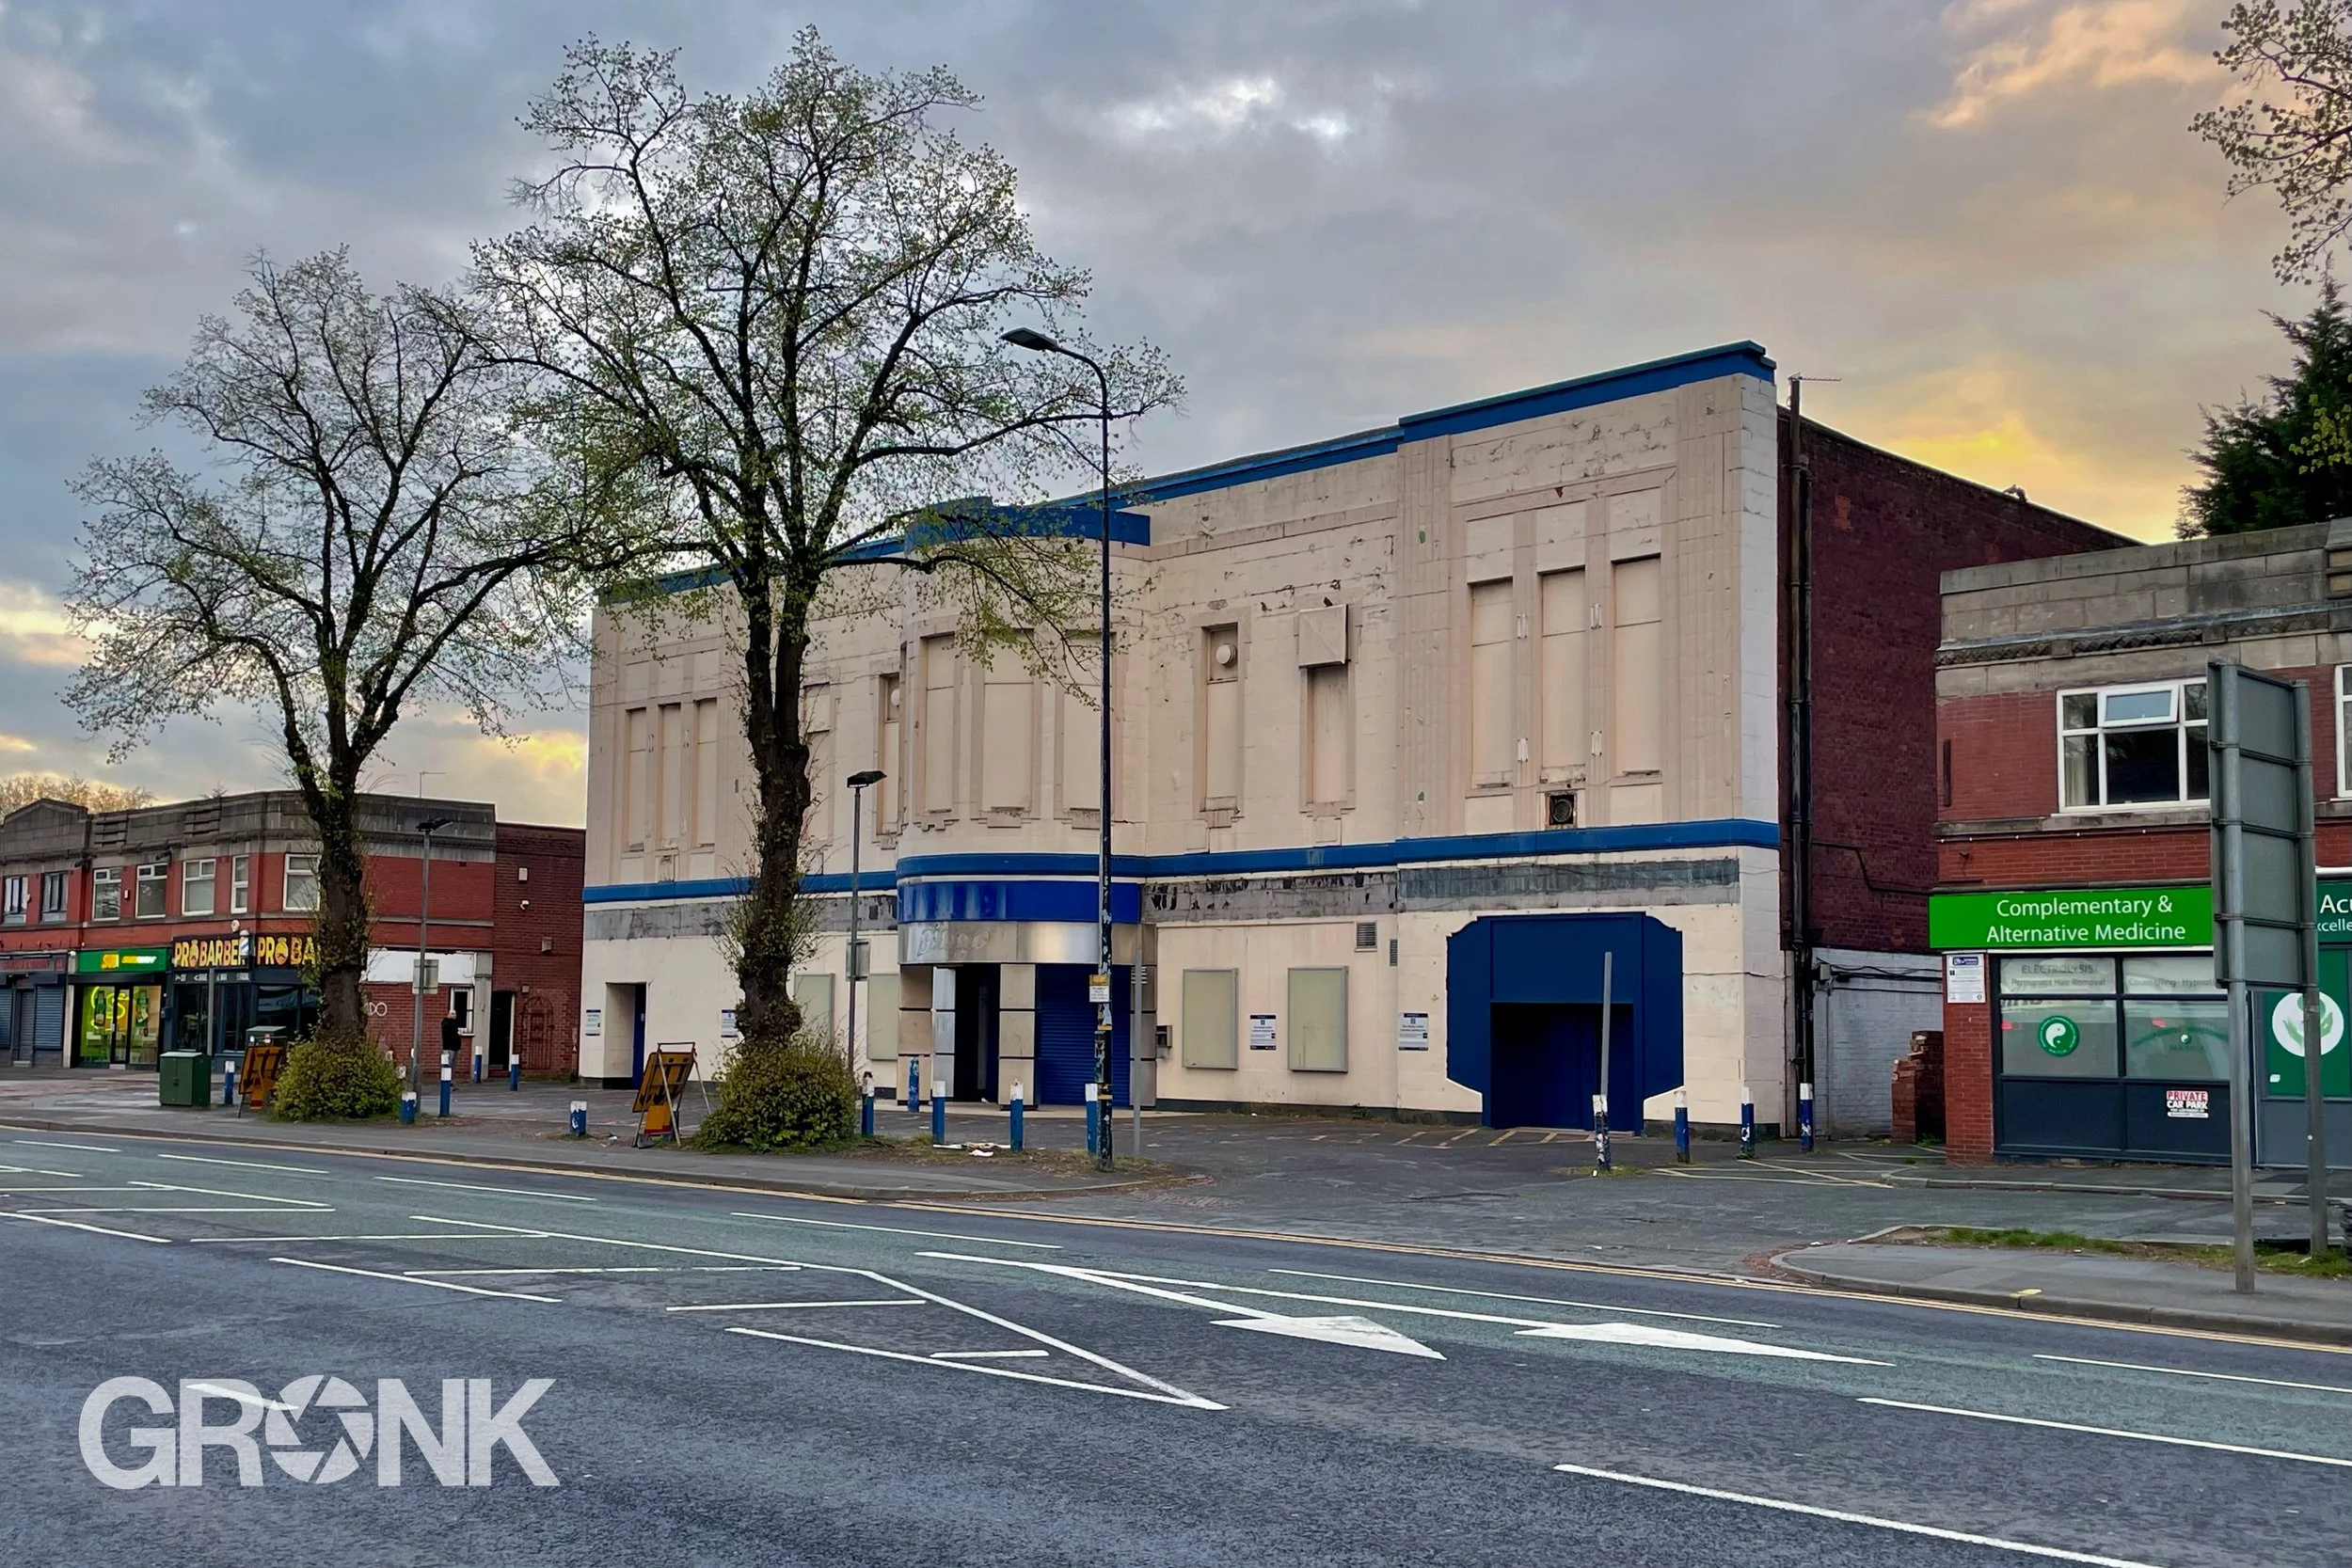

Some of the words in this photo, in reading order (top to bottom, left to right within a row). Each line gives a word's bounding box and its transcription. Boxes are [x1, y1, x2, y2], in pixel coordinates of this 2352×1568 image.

[1996, 897, 2153, 920] Complementary
[2157, 895, 2173, 913] &
[2319, 894, 2352, 914] Ac
[1986, 925, 2090, 942] Alternative
[2094, 923, 2186, 942] Medicine
[2021, 964, 2094, 974] ELECTROLYSIS
[2167, 1091, 2207, 1101] PRIVATE
[2167, 1101, 2185, 1109] CAR
[2185, 1101, 2208, 1110] PARK
